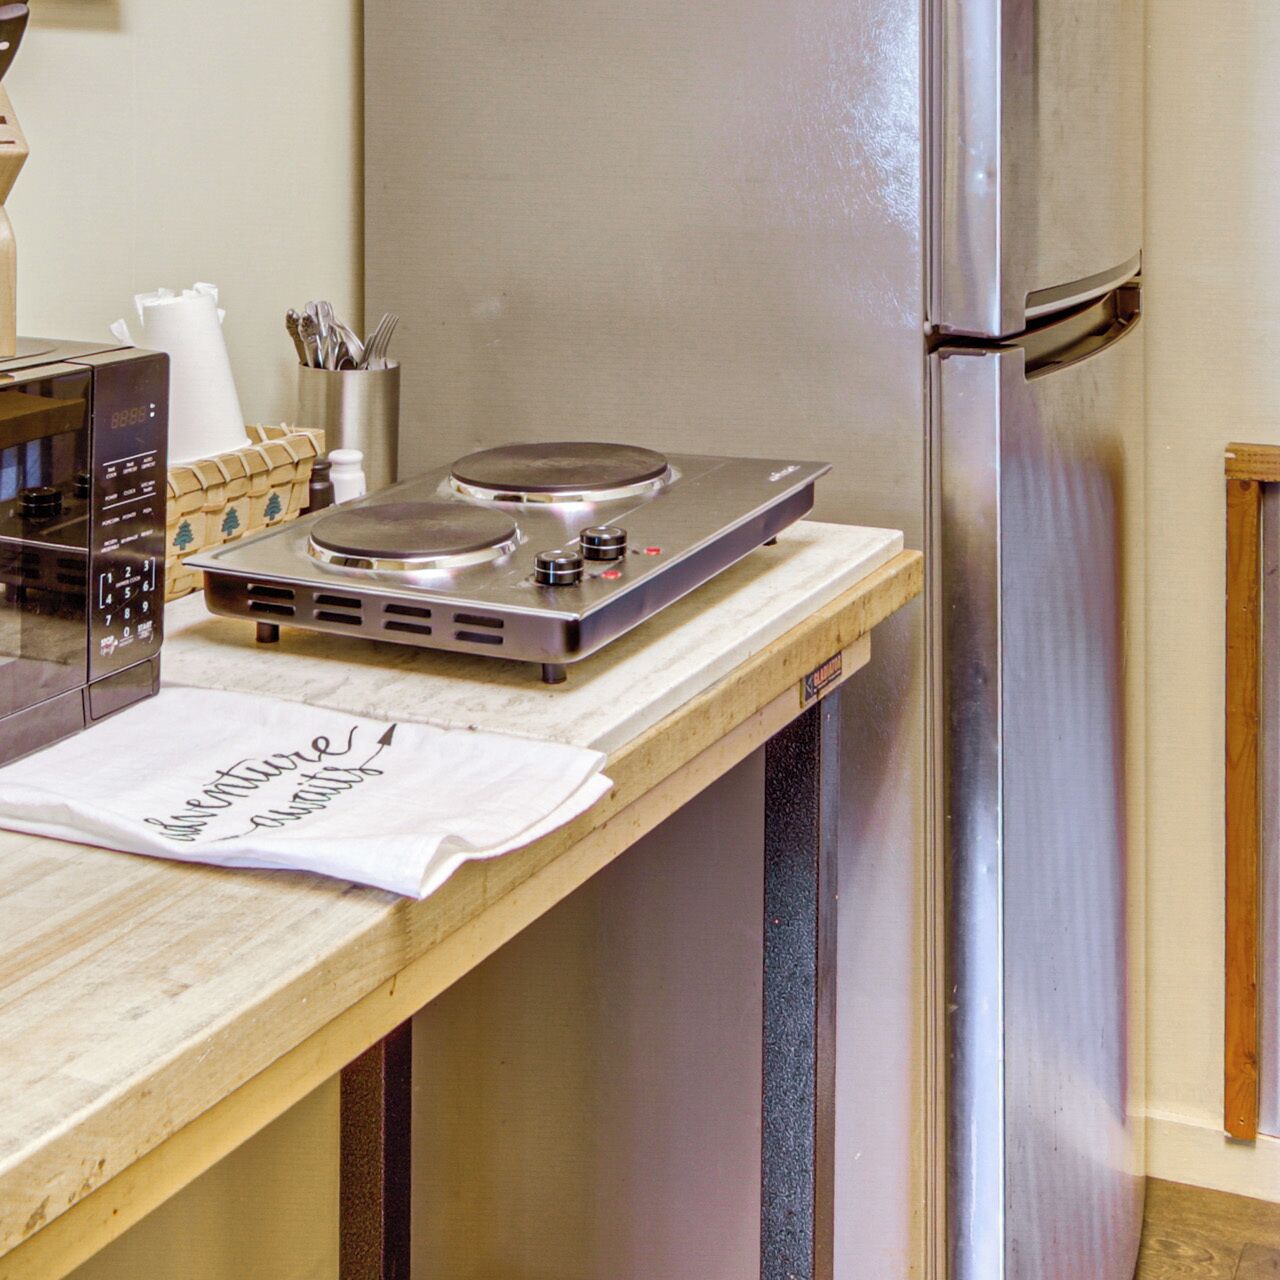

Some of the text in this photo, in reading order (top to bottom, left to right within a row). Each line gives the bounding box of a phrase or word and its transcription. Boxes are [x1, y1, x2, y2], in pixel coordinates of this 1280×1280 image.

[125, 566, 131, 578] 2
[143, 560, 149, 572] 3
[107, 573, 112, 583] 1
[142, 580, 149, 592] 6
[124, 586, 131, 599] 5
[105, 593, 112, 605] 4
[124, 607, 130, 619] 8
[142, 601, 149, 613] 9
[105, 614, 112, 626] 7
[123, 626, 130, 637] 0
[248, 765, 384, 829] awaits
